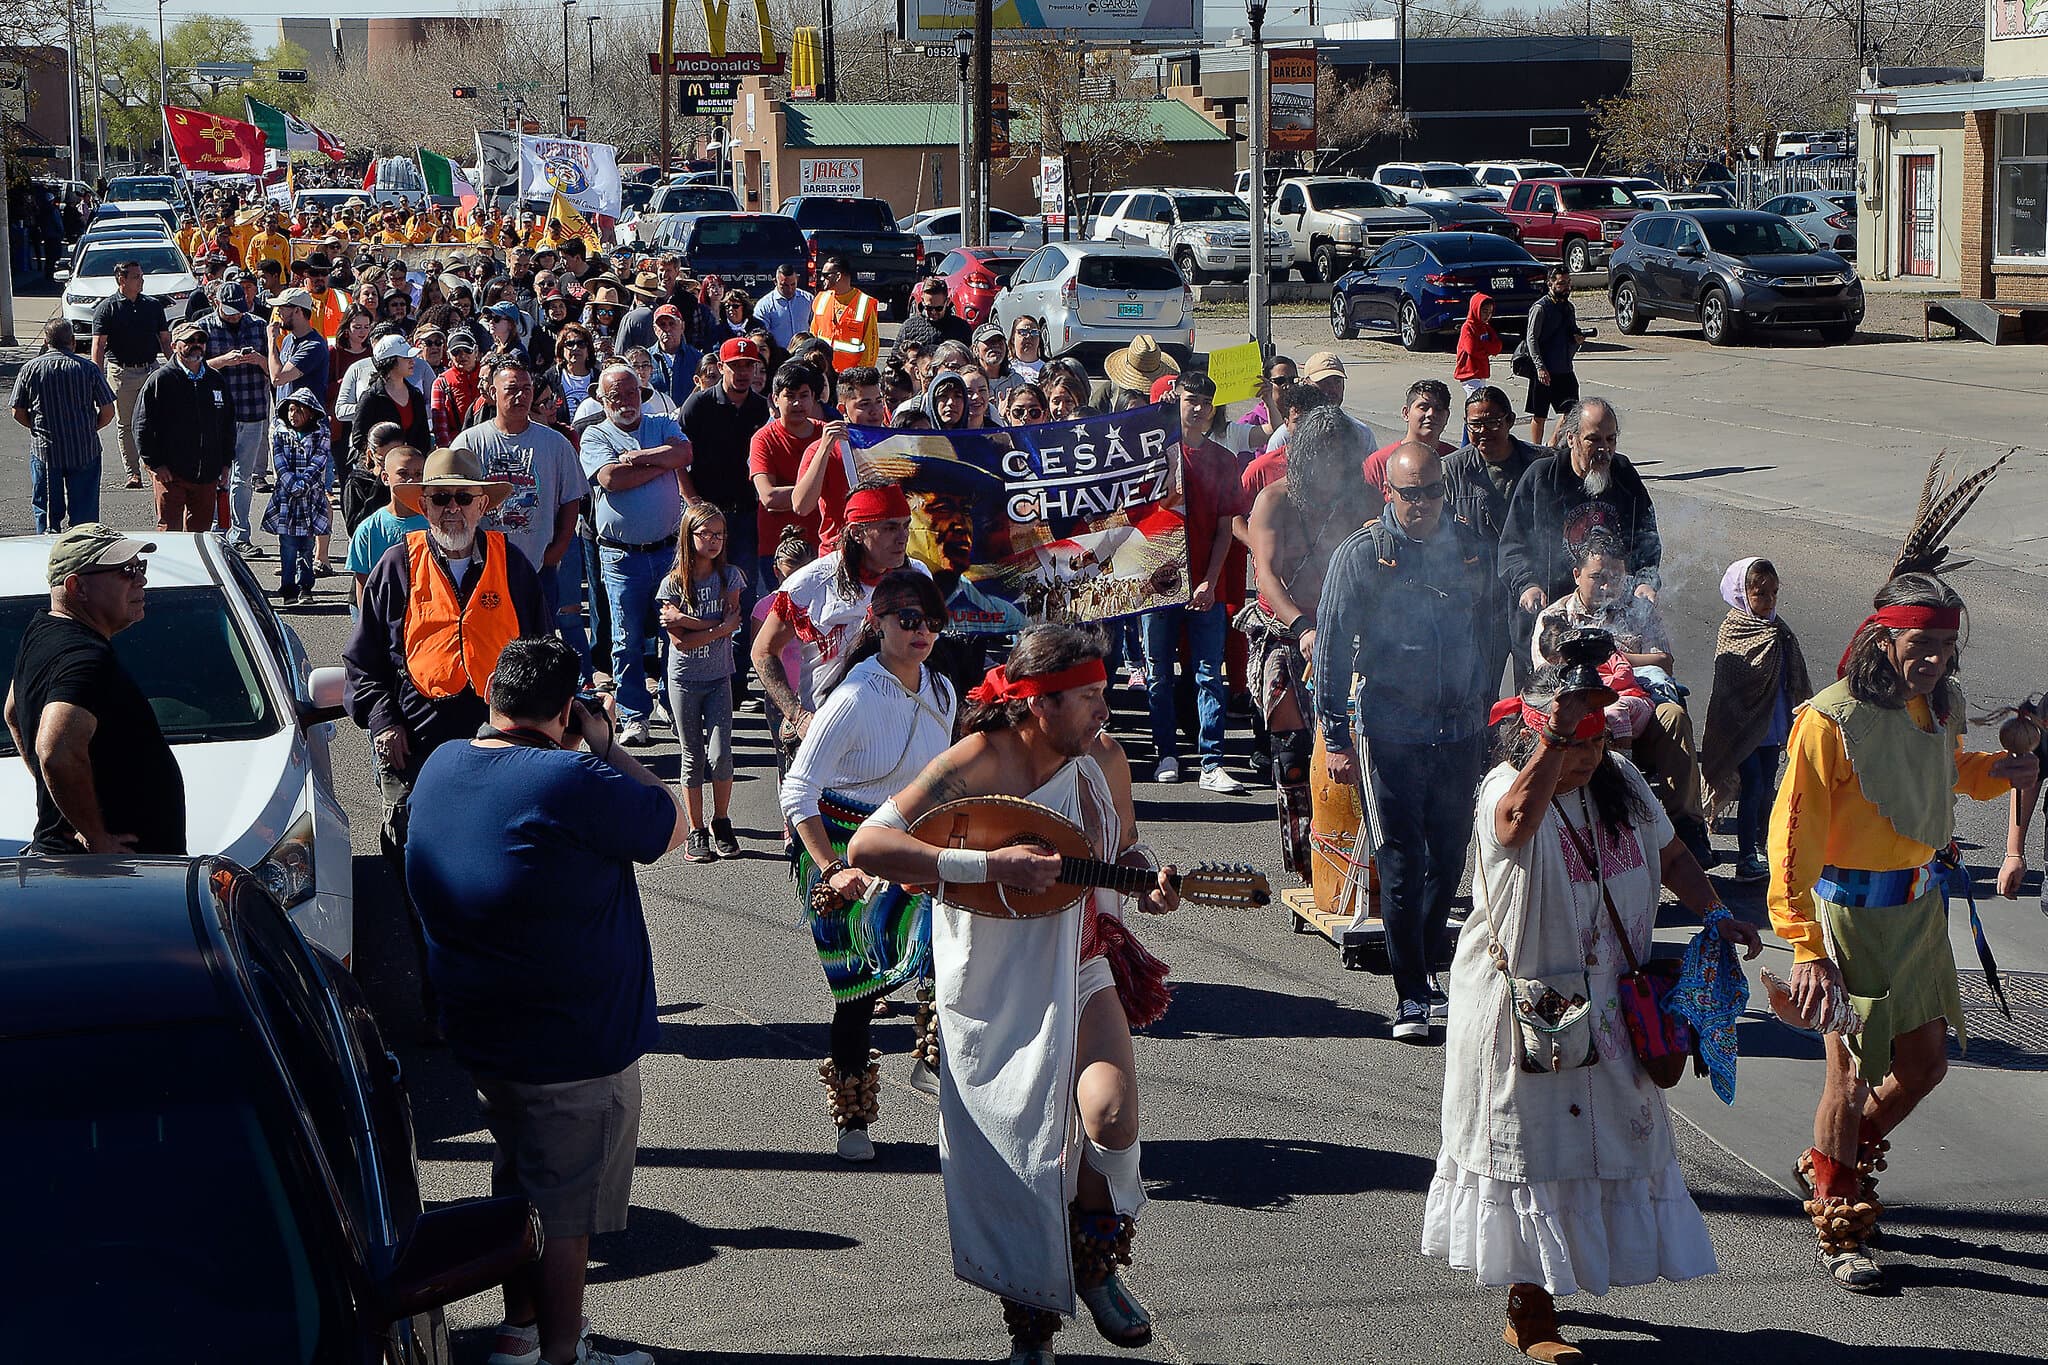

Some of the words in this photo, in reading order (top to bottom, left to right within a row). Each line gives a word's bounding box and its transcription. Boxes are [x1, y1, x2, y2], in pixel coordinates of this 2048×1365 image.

[676, 59, 761, 72] McDonald's
[1273, 65, 1313, 78] BARELAS
[812, 161, 859, 183] JAKE'S
[803, 184, 837, 193] BARBER
[838, 184, 861, 193] SHOP
[697, 274, 801, 282] CEVROL
[1007, 468, 1169, 523] CHAVEZ
